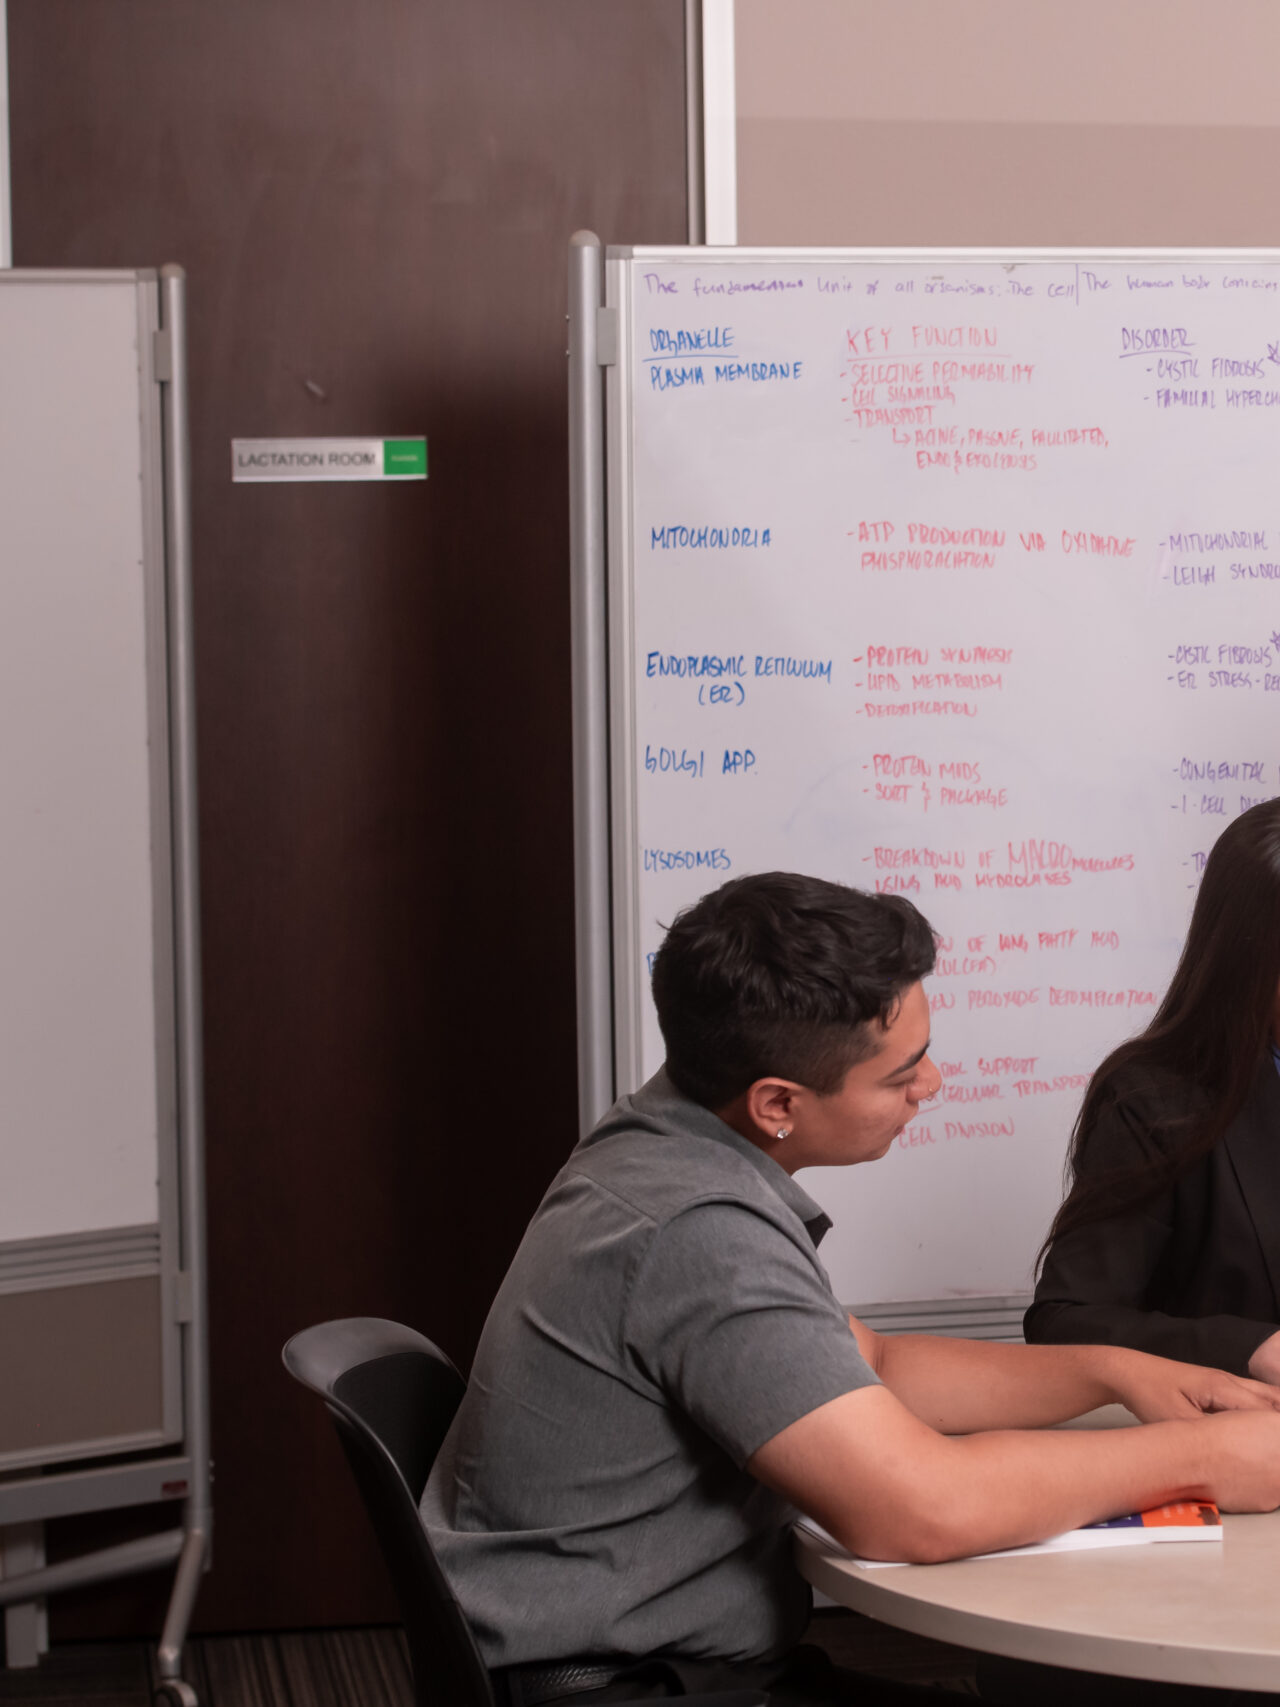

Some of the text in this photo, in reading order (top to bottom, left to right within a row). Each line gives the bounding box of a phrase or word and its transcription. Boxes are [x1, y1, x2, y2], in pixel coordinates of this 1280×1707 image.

[644, 273, 679, 296] The
[1081, 271, 1112, 291] The
[650, 326, 736, 357] ORGANELLE
[846, 324, 999, 354] KEY FUNCTION
[1121, 326, 1196, 351] DISORDER
[651, 361, 803, 392] PLASMA MEMBRANE
[851, 362, 924, 387] SELECTIVE
[853, 404, 938, 428] TRANSPORT
[237, 451, 325, 469] LACTATION
[327, 450, 376, 468] ROOM
[650, 525, 773, 550] MITOCHONDRIA
[858, 520, 895, 543] ATP
[907, 522, 1006, 548] PRODUCTION
[1019, 532, 1047, 552] VIA
[646, 650, 747, 678] ENDOPLASMIC
[866, 672, 901, 692] LIPID
[645, 744, 705, 778] GOLGI
[871, 752, 933, 779] PROTEIN
[644, 848, 732, 873] LYSOSOMES
[873, 846, 967, 871] BREAKDOWN
[977, 849, 997, 869] OF
[977, 1055, 1041, 1078] SUPPORT
[945, 1116, 1017, 1143] DIVISION
